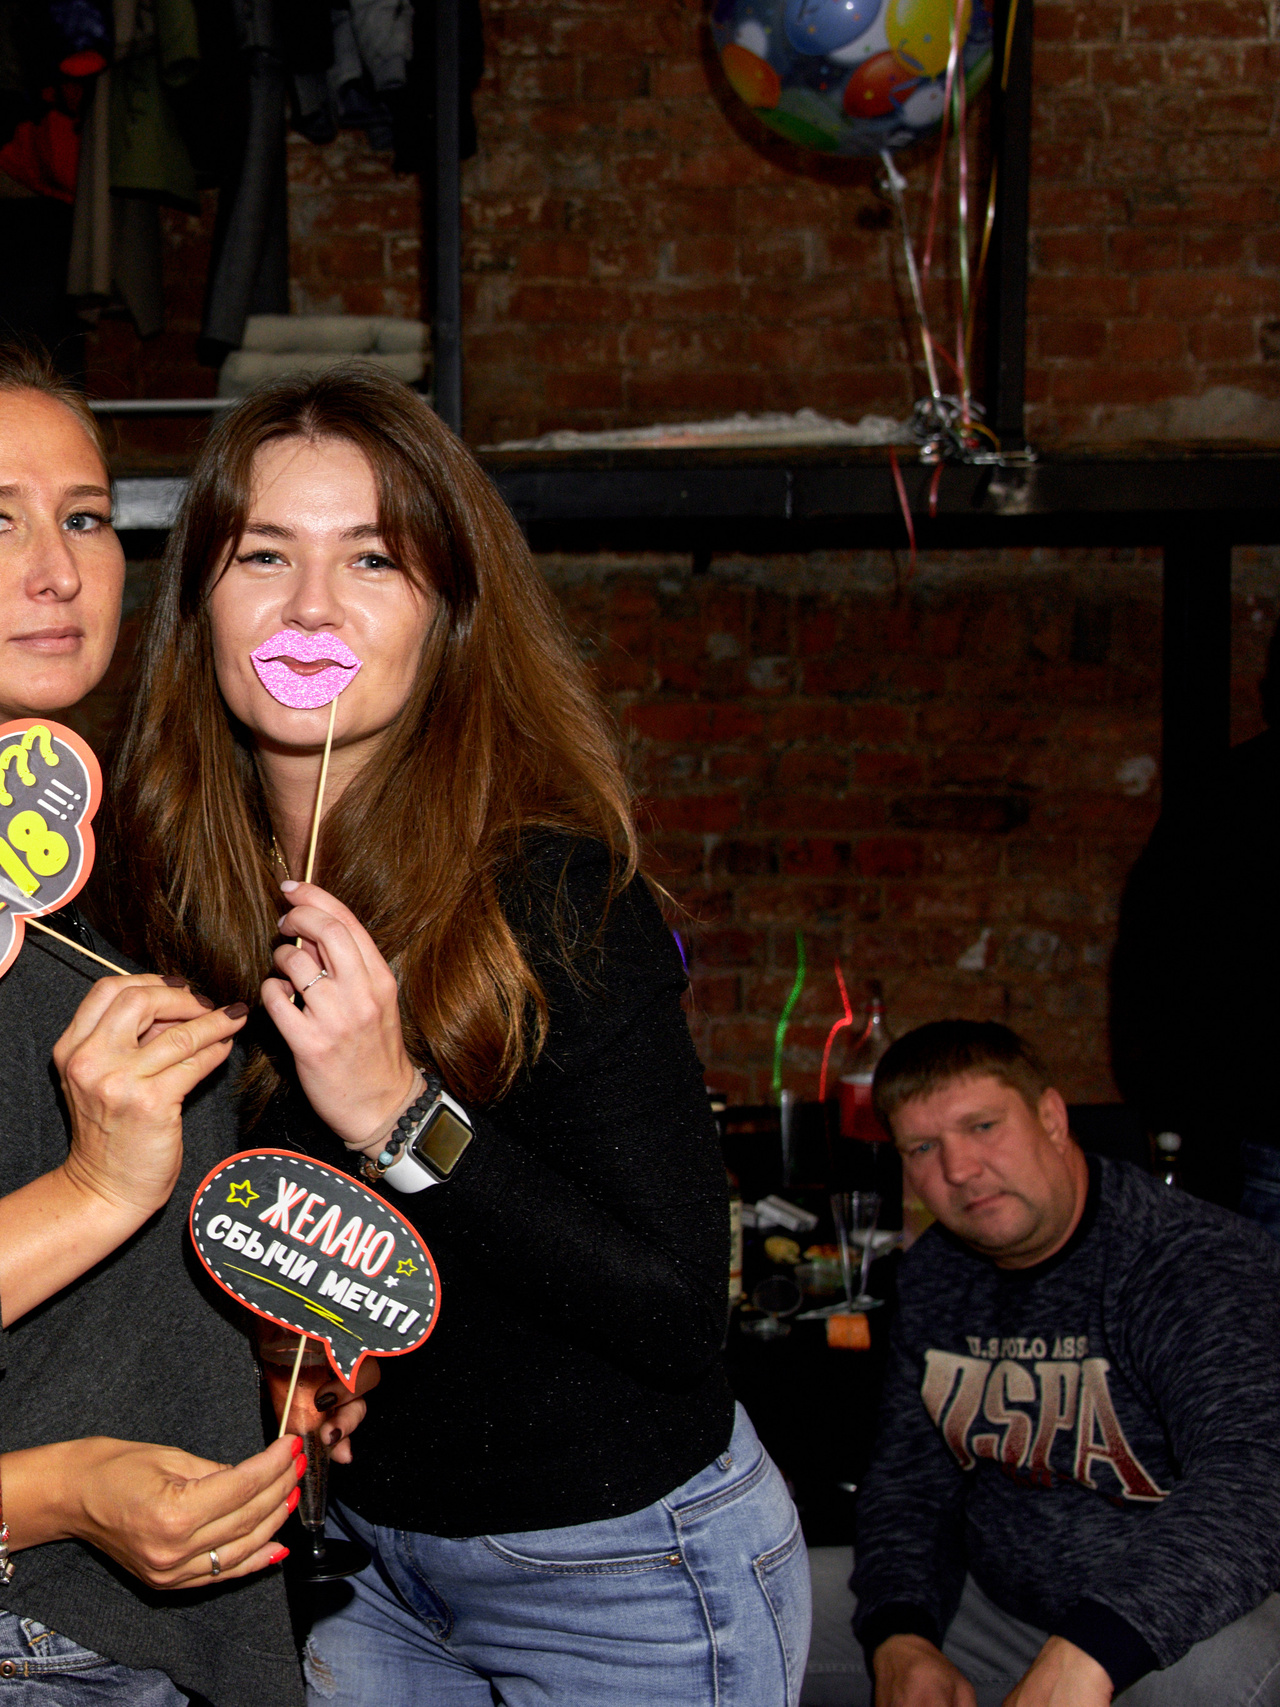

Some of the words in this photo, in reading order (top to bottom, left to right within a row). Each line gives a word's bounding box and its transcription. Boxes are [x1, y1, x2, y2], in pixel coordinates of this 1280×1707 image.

[206, 1214, 319, 1287] СБЫЧИ
[318, 1270, 420, 1335] МЕЧТ!
[258, 1177, 397, 1278] ЖЕЛАЮ
